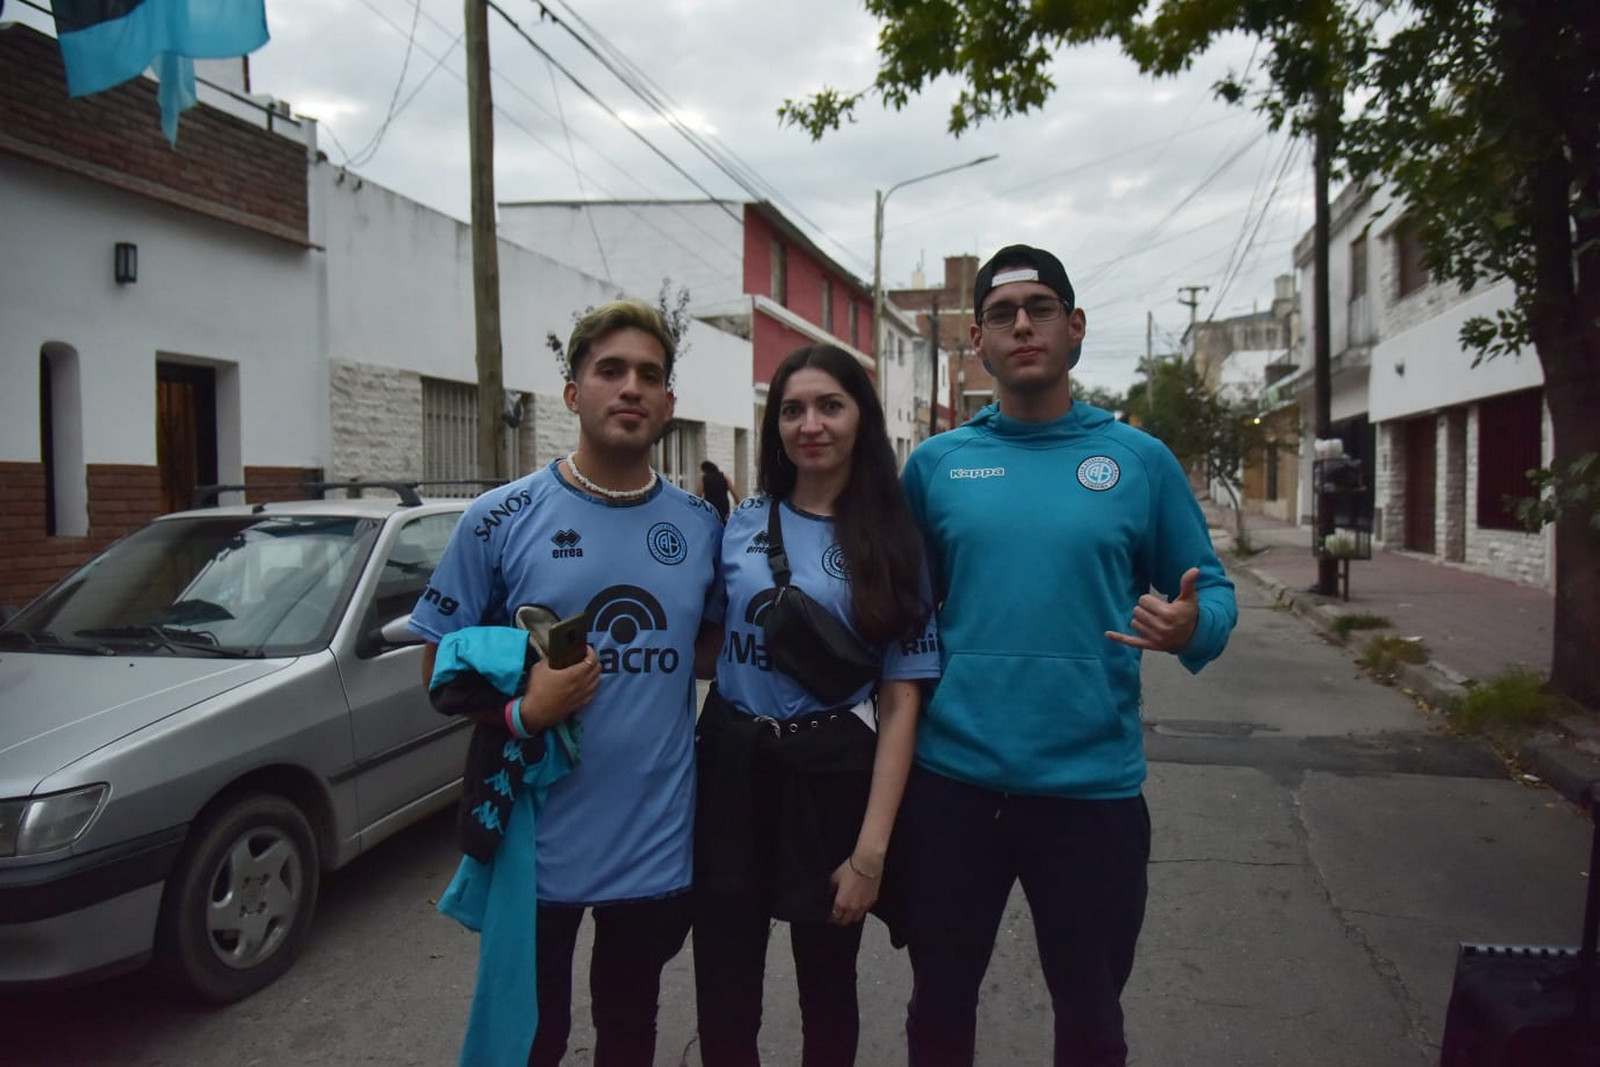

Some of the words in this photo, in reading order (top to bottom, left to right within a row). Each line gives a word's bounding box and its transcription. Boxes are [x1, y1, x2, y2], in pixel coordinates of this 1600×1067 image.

[950, 467, 1005, 479] Kappa
[474, 489, 533, 543] SANOS
[588, 643, 679, 674] acro
